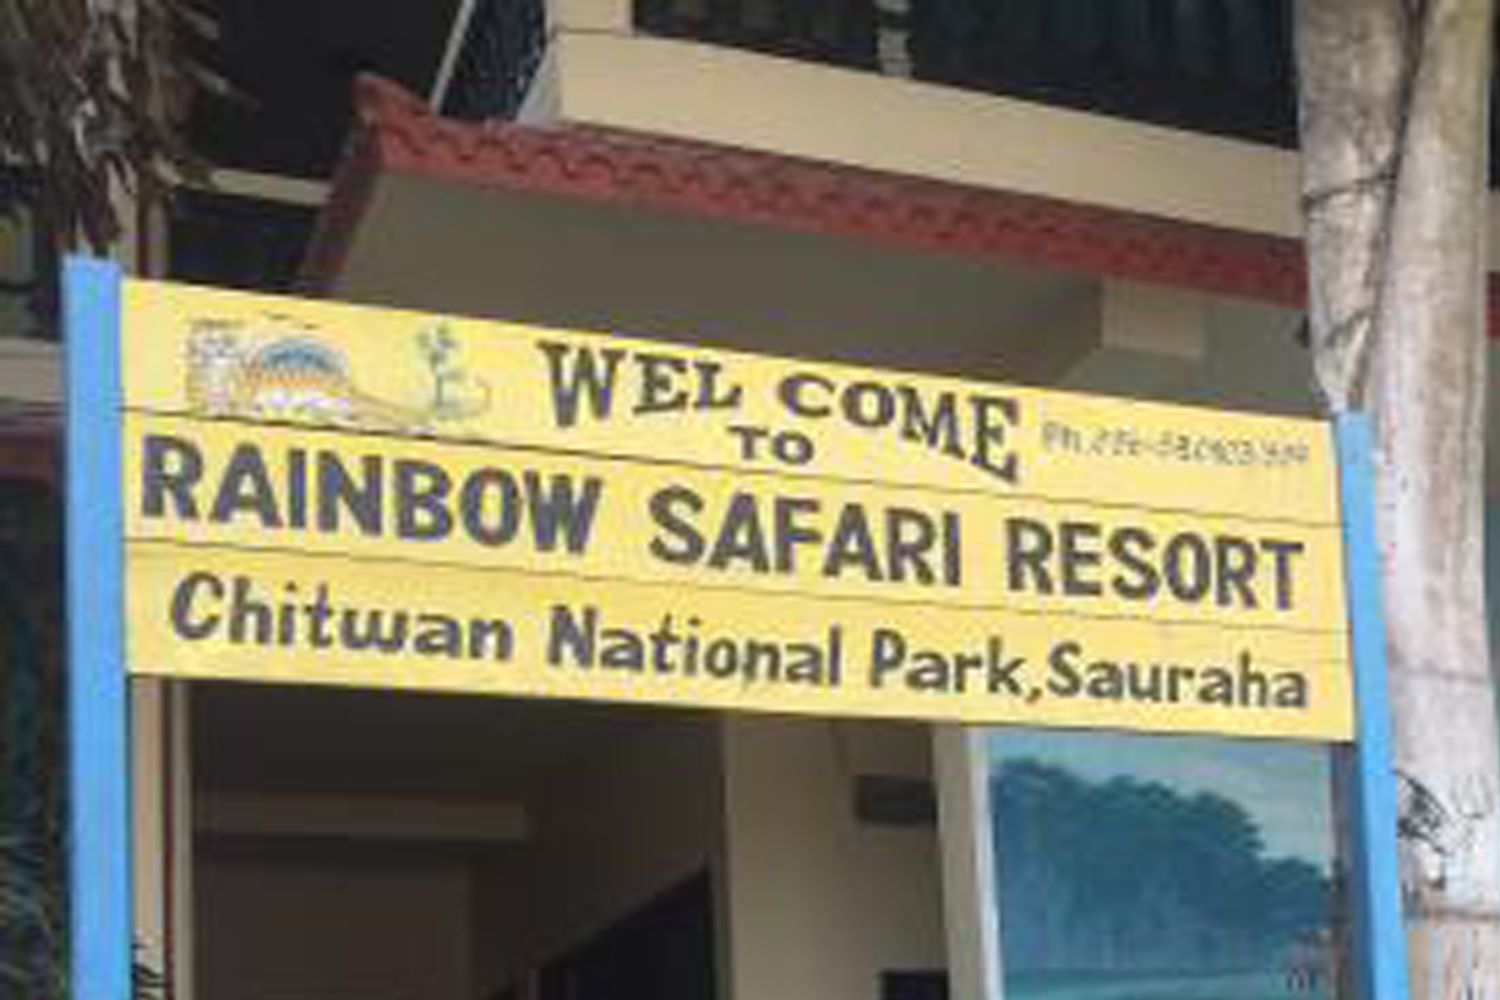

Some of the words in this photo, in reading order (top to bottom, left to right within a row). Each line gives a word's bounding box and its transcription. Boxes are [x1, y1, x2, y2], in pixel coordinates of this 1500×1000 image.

[728, 426, 813, 465] TO
[141, 434, 603, 555] RAINBOW
[650, 485, 961, 587] SAFARI
[1006, 518, 1305, 610] RESORT
[170, 571, 512, 661] Chitwan
[548, 604, 842, 686] National
